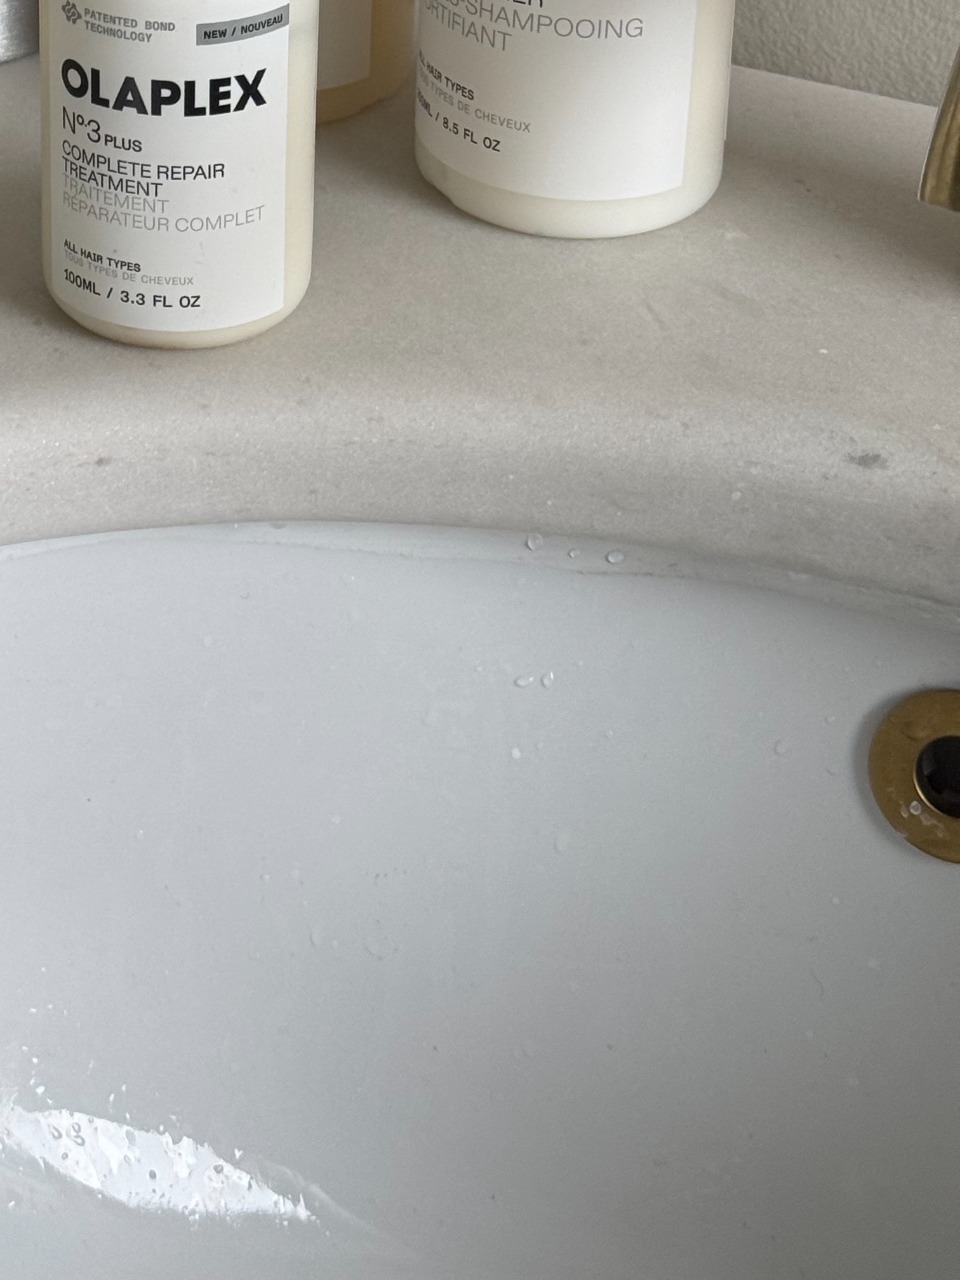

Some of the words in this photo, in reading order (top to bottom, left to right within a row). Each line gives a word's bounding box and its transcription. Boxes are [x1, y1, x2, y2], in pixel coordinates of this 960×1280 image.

[84, 8, 138, 29] PATENTED
[144, 20, 176, 32] BOND
[84, 20, 152, 43] TECHNOLOGY
[203, 28, 227, 40] NEW
[231, 27, 236, 36] /
[240, 14, 283, 35] NOUVEAU
[61, 58, 267, 117] OLAPLEX
[426, 61, 442, 83] HAIR
[444, 76, 475, 101] TYPES
[430, 81, 454, 106] TYPES
[457, 100, 471, 115] DE
[474, 108, 531, 133] CHEVEUX
[104, 133, 143, 152] PLUS
[442, 117, 459, 135] 8.5
[463, 128, 478, 144] FL
[482, 136, 501, 152] OZ
[61, 155, 163, 197] TREATMENT
[62, 139, 152, 179] COMPLETE
[157, 163, 225, 181] REPAIR
[62, 173, 170, 214] TRAITEMENT
[175, 204, 265, 232] COMPLET
[64, 238, 78, 254] ALL
[80, 246, 103, 264] HAIR
[106, 257, 141, 273] TYPES
[64, 249, 84, 267] TOUS
[87, 261, 117, 278] TYPES
[122, 271, 136, 282] DE
[141, 275, 194, 286] CHEVEUX
[64, 268, 101, 296] 100ML
[106, 287, 113, 299] /
[120, 290, 145, 306] 3.3
[153, 295, 173, 308] FL
[179, 295, 201, 308] OZ
